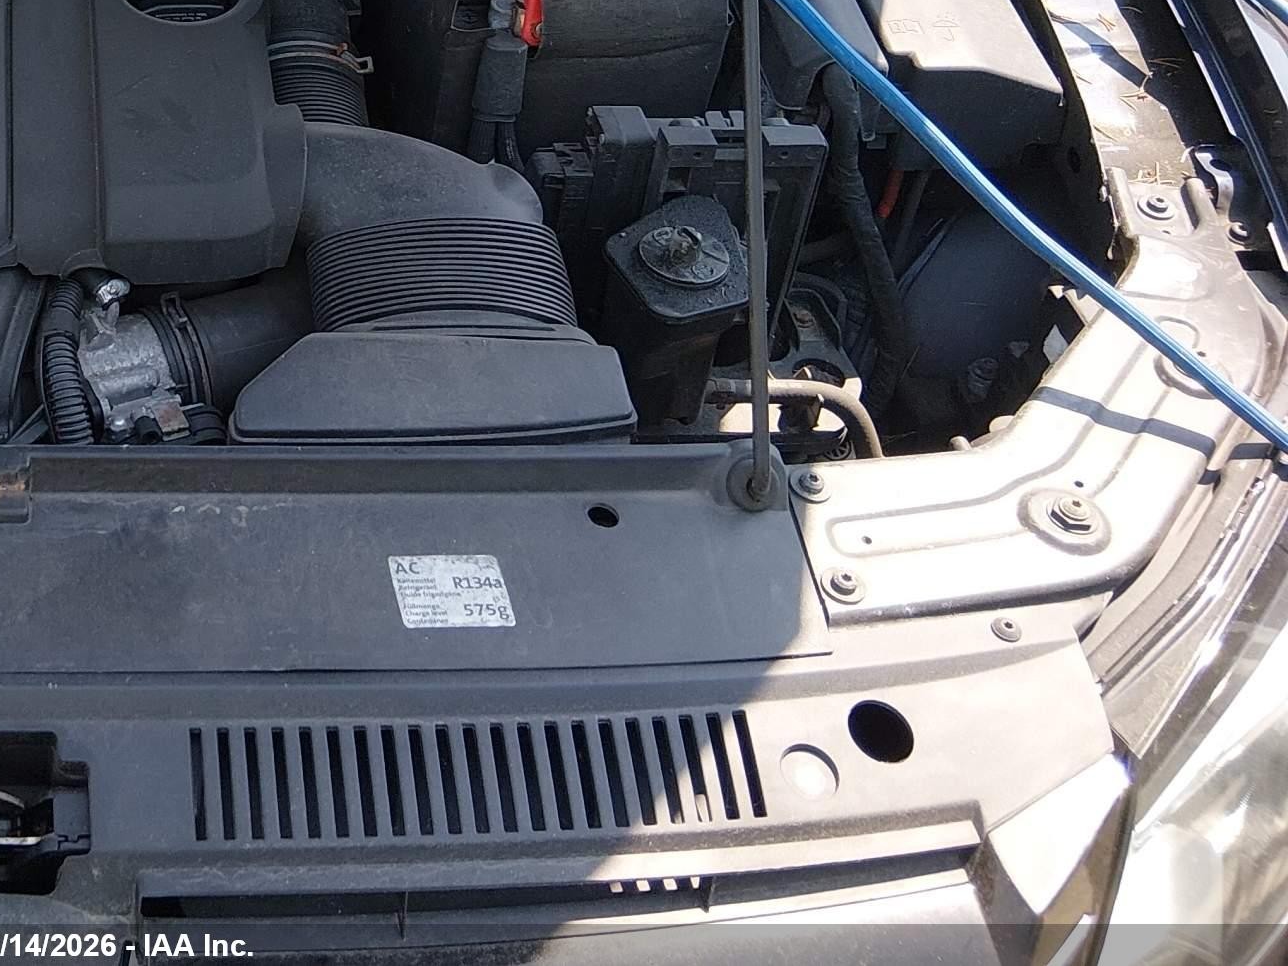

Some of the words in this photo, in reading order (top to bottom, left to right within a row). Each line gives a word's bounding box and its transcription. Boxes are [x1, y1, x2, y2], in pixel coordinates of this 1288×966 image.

[395, 561, 421, 575] AC
[451, 575, 503, 589] R134a
[463, 603, 510, 620] 575g
